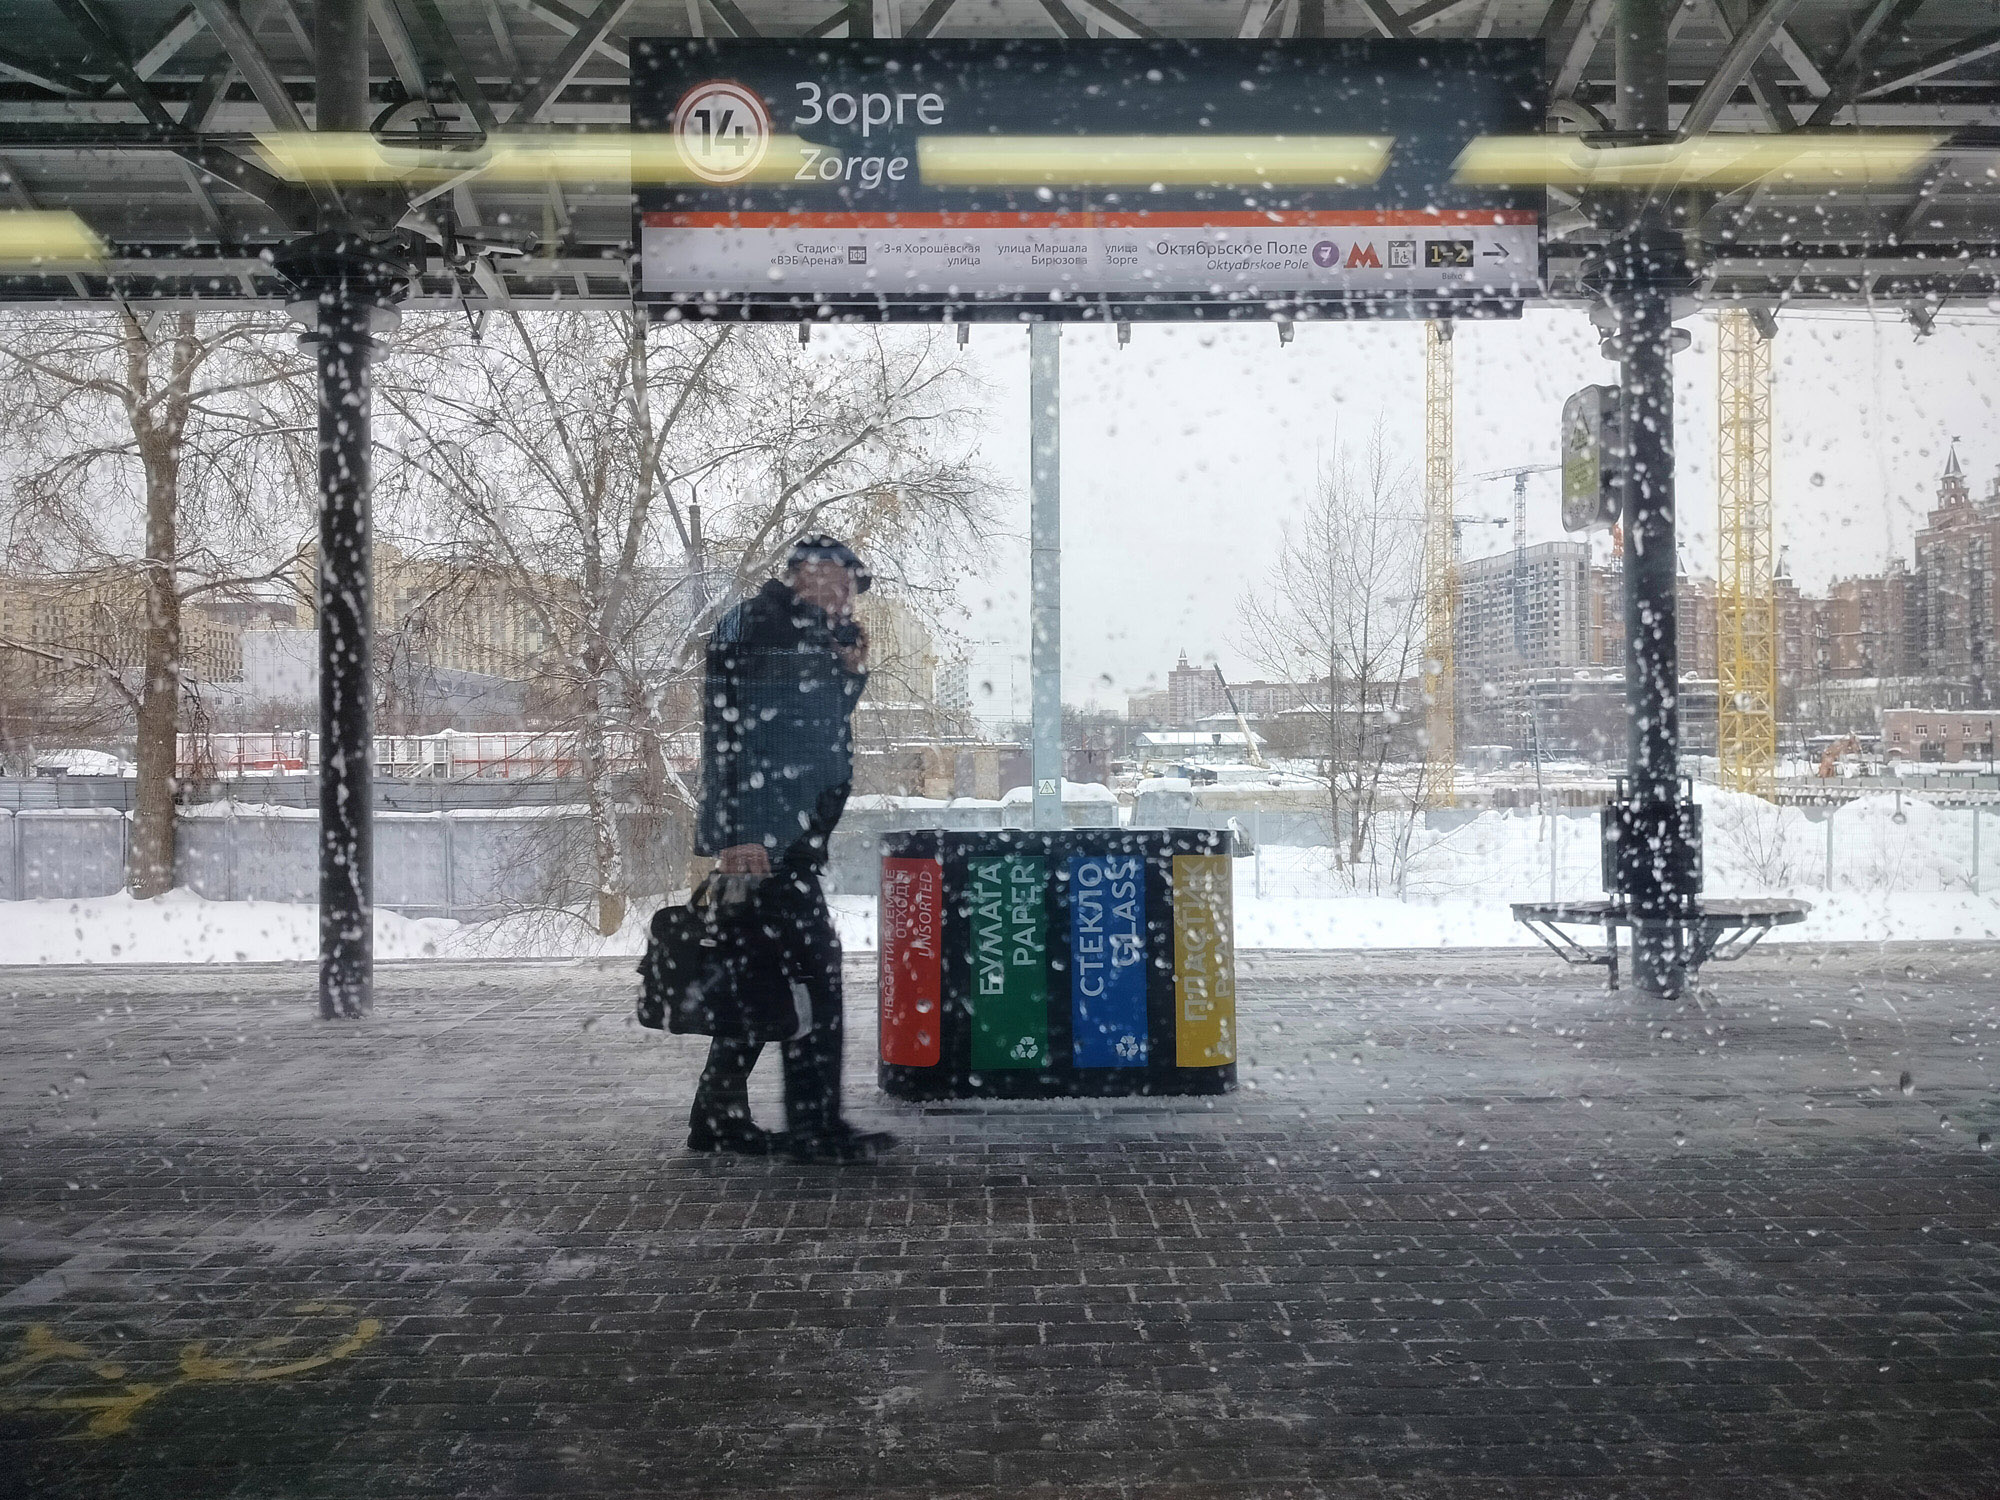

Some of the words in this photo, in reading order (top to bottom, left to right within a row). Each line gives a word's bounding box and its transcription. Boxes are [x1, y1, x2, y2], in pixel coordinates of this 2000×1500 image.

[794, 81, 945, 138] Зорге
[694, 109, 750, 157] 14
[794, 148, 909, 190] Zorge
[796, 243, 844, 255] Стадион
[884, 243, 902, 254] 3-я
[904, 243, 981, 256] Хорошёвская
[998, 245, 1031, 256] улица
[1034, 243, 1088, 255] Маршала
[1105, 245, 1138, 256] улица
[1156, 241, 1263, 258] Октябрьское
[1267, 241, 1308, 255] Поле
[1320, 246, 1332, 262] 7
[1430, 245, 1468, 263] 1-2
[770, 255, 799, 265] «ВЭБ
[801, 255, 844, 267] Арена»
[947, 257, 981, 267] улица
[1031, 255, 1088, 267] Бирюзова
[1105, 255, 1138, 267] Зорге
[1207, 259, 1281, 272] Oktyabrskoe
[1284, 259, 1309, 270] Pole
[1442, 272, 1467, 280] Выхо
[896, 870, 909, 939] ОТХОДЫ
[918, 871, 933, 957] UNSORTED
[1011, 862, 1037, 966] PAPER
[1111, 860, 1137, 967] GLASS
[978, 862, 1004, 995] БУМАГА
[1077, 863, 1104, 997] СТЕКЛО
[1181, 861, 1208, 1021] ПЛАСТИК
